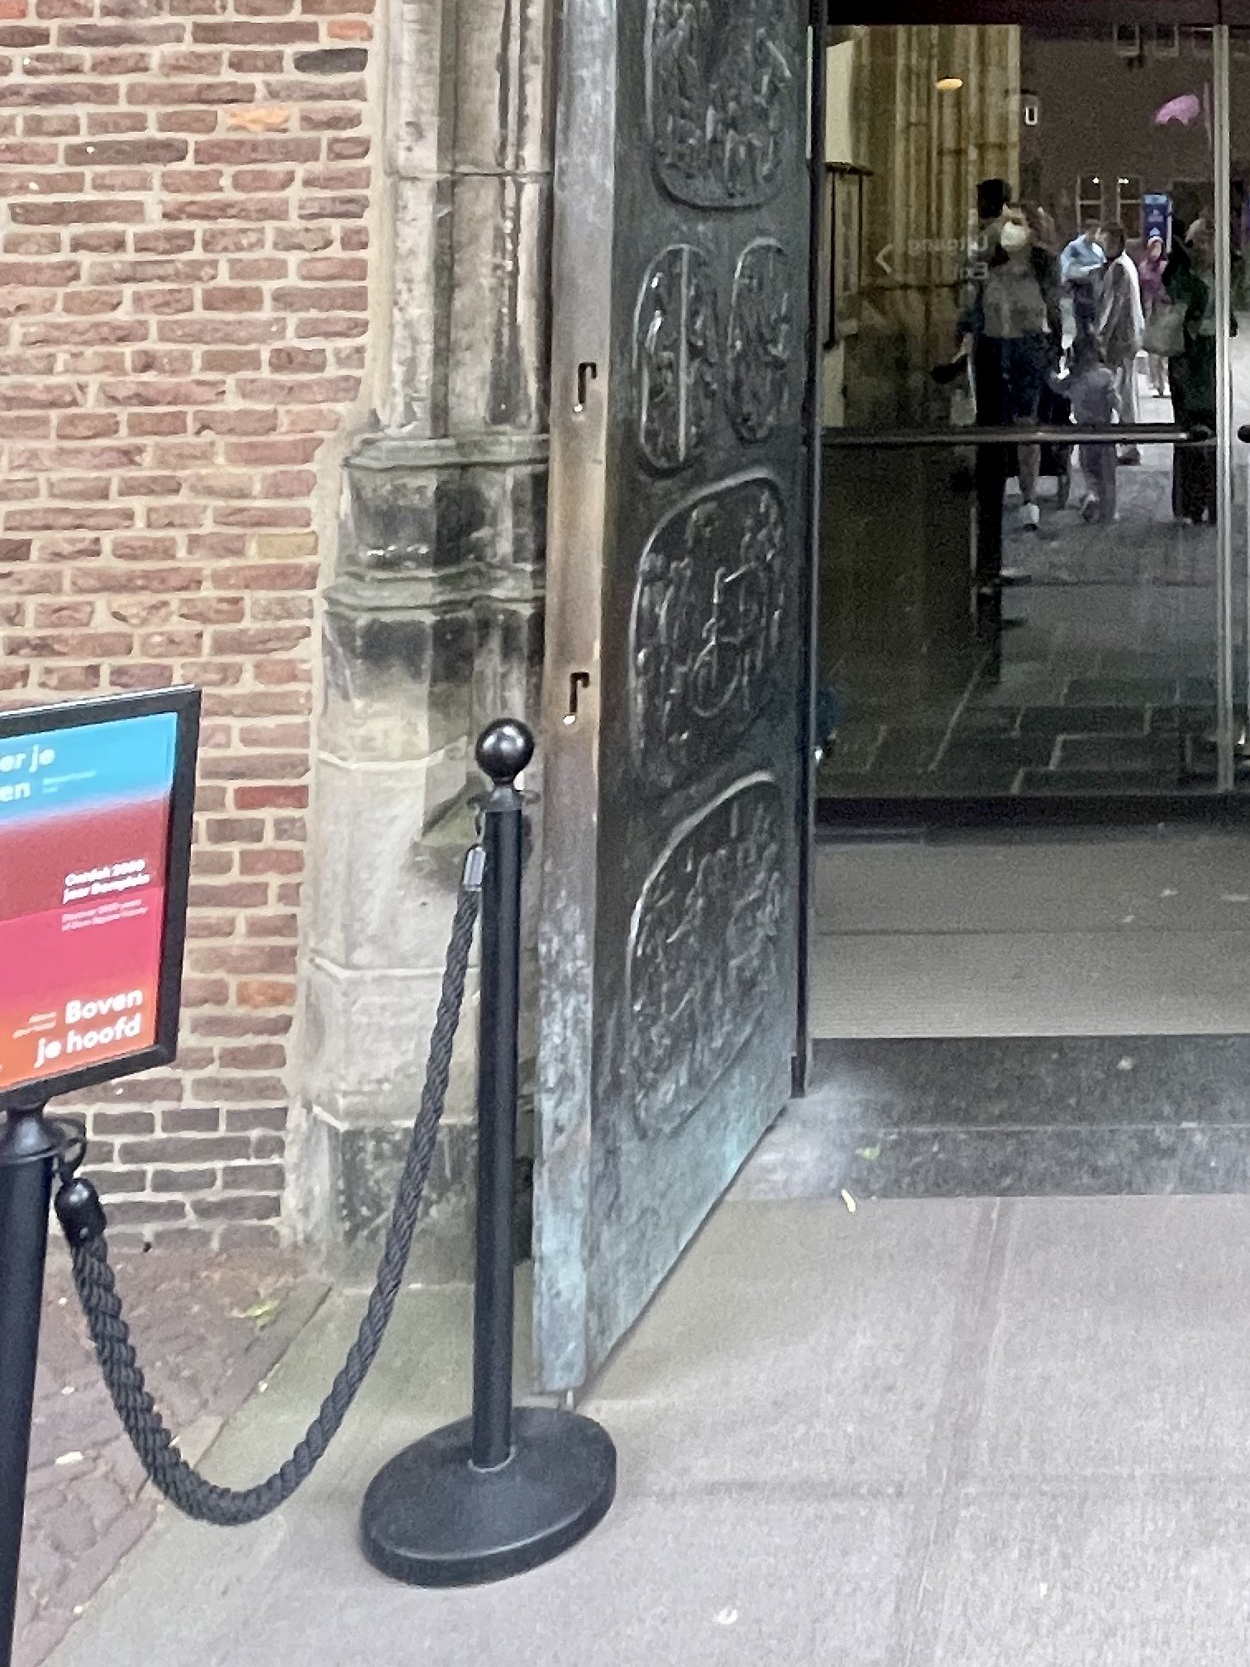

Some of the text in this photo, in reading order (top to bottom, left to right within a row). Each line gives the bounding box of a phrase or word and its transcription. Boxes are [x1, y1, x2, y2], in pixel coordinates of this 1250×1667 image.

[65, 989, 143, 1024] Boven
[33, 1037, 61, 1069] je
[66, 1012, 142, 1054] hoofd
